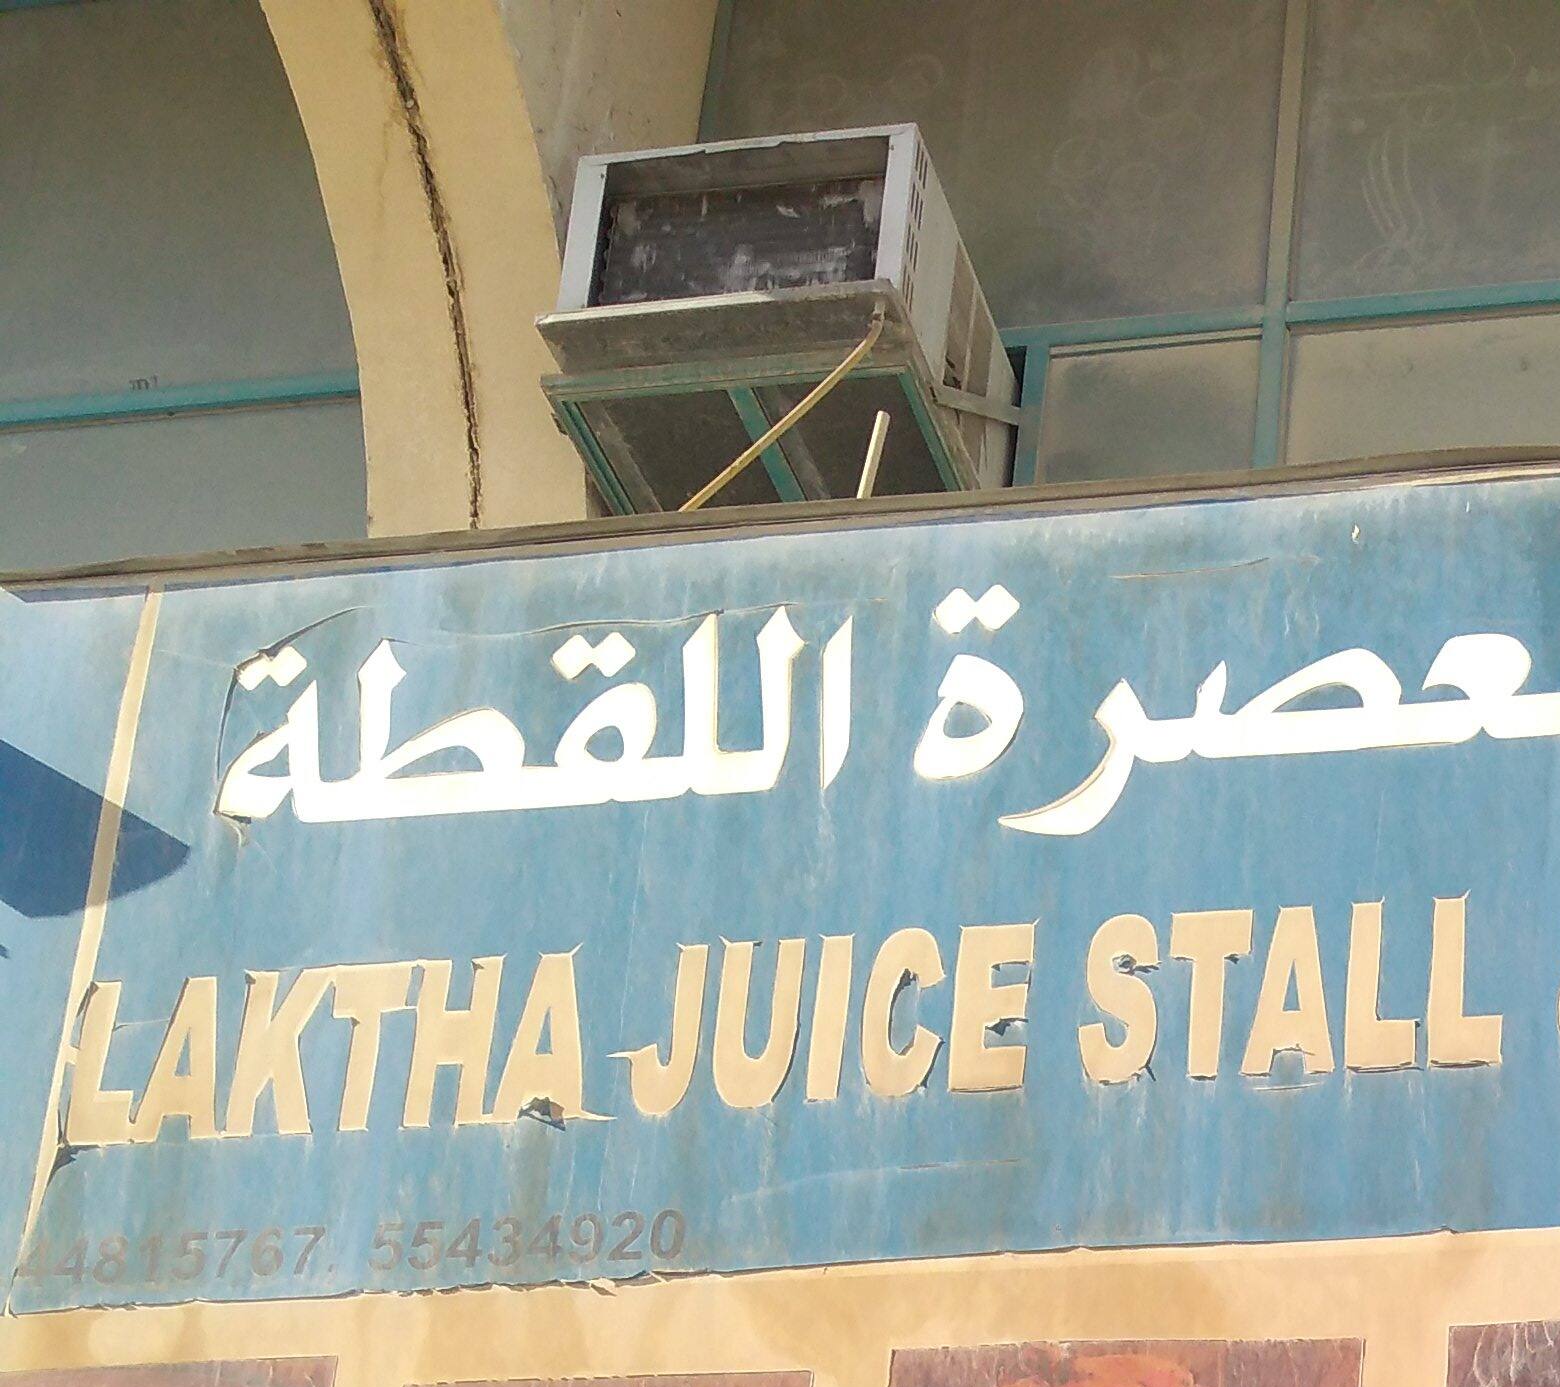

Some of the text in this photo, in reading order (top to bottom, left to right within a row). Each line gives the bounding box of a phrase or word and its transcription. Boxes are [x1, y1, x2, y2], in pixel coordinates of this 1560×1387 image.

[214, 603, 853, 825] اللقطة
[60, 950, 600, 1146] LAKTHA
[612, 920, 1038, 1119] JUICE
[1078, 893, 1504, 1086] STALL
[367, 1208, 687, 1275] 55434920
